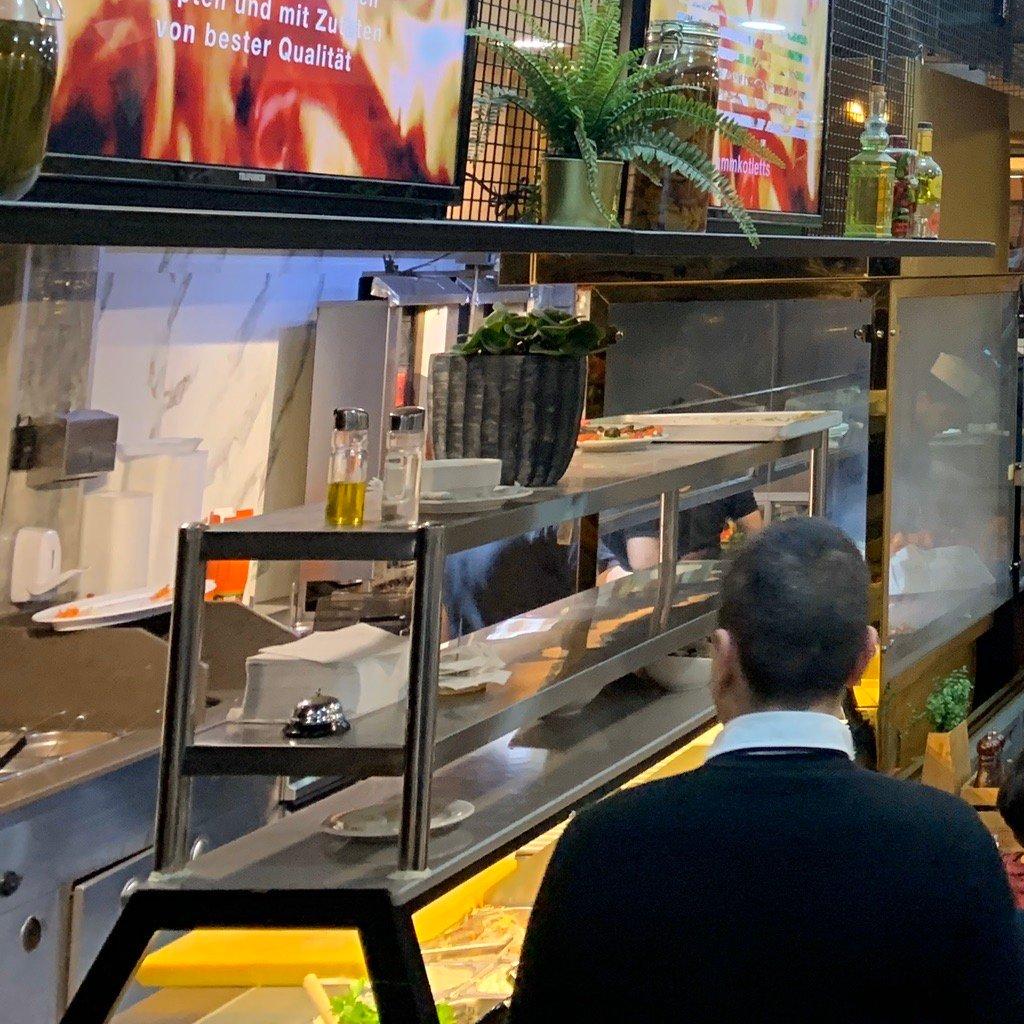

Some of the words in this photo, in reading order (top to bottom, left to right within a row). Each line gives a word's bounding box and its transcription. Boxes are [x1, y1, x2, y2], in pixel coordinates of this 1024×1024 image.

[156, 19, 196, 44] von
[204, 22, 272, 58] bester
[278, 36, 352, 73] Qualität
[279, 3, 310, 29] mit
[315, 8, 383, 43] Zuten
